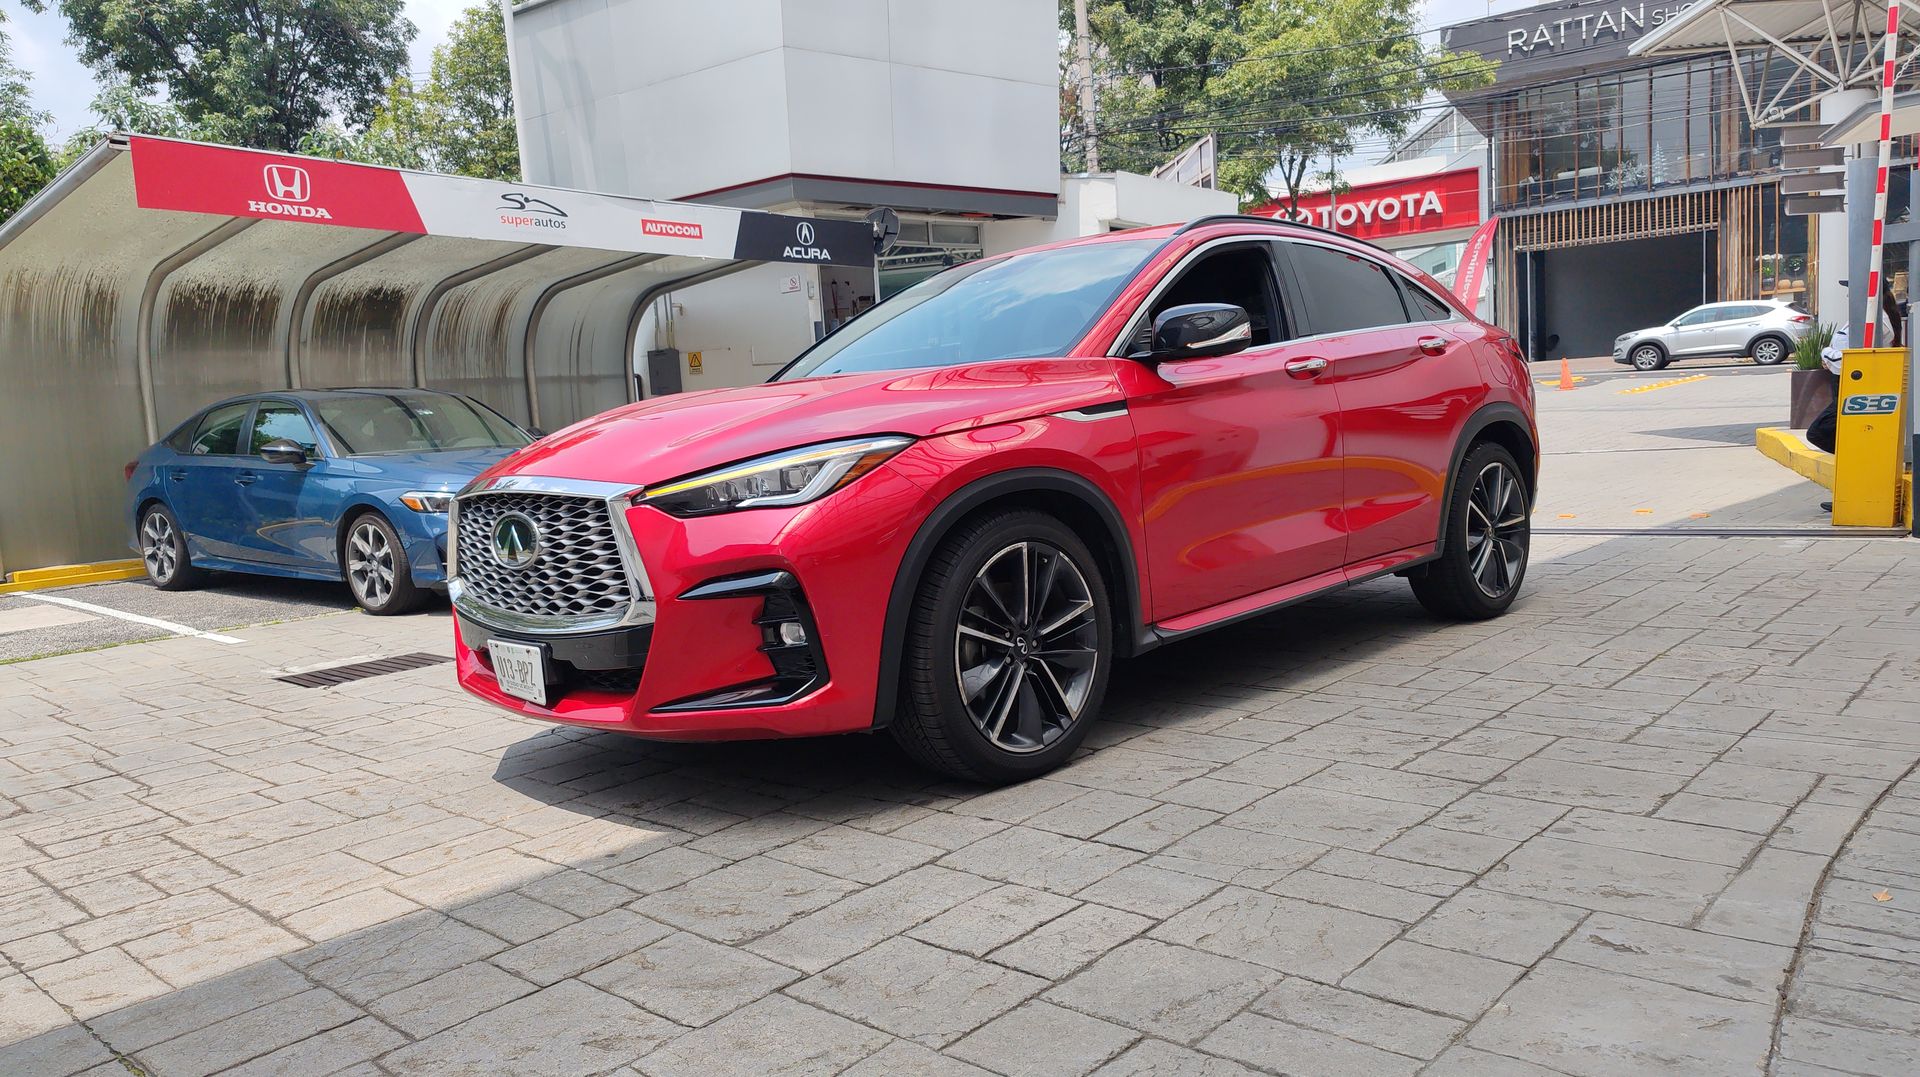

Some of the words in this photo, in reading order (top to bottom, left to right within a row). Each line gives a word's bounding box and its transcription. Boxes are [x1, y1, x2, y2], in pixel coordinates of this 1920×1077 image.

[1507, 3, 1644, 54] RATTAN
[1652, 3, 1693, 25] SH
[248, 200, 333, 219] HONDA
[1316, 191, 1443, 229] TOYOTA
[500, 214, 566, 230] superautos
[645, 222, 700, 237] AUTOCOM
[783, 246, 831, 260] ACURA
[1847, 395, 1898, 411] SEG
